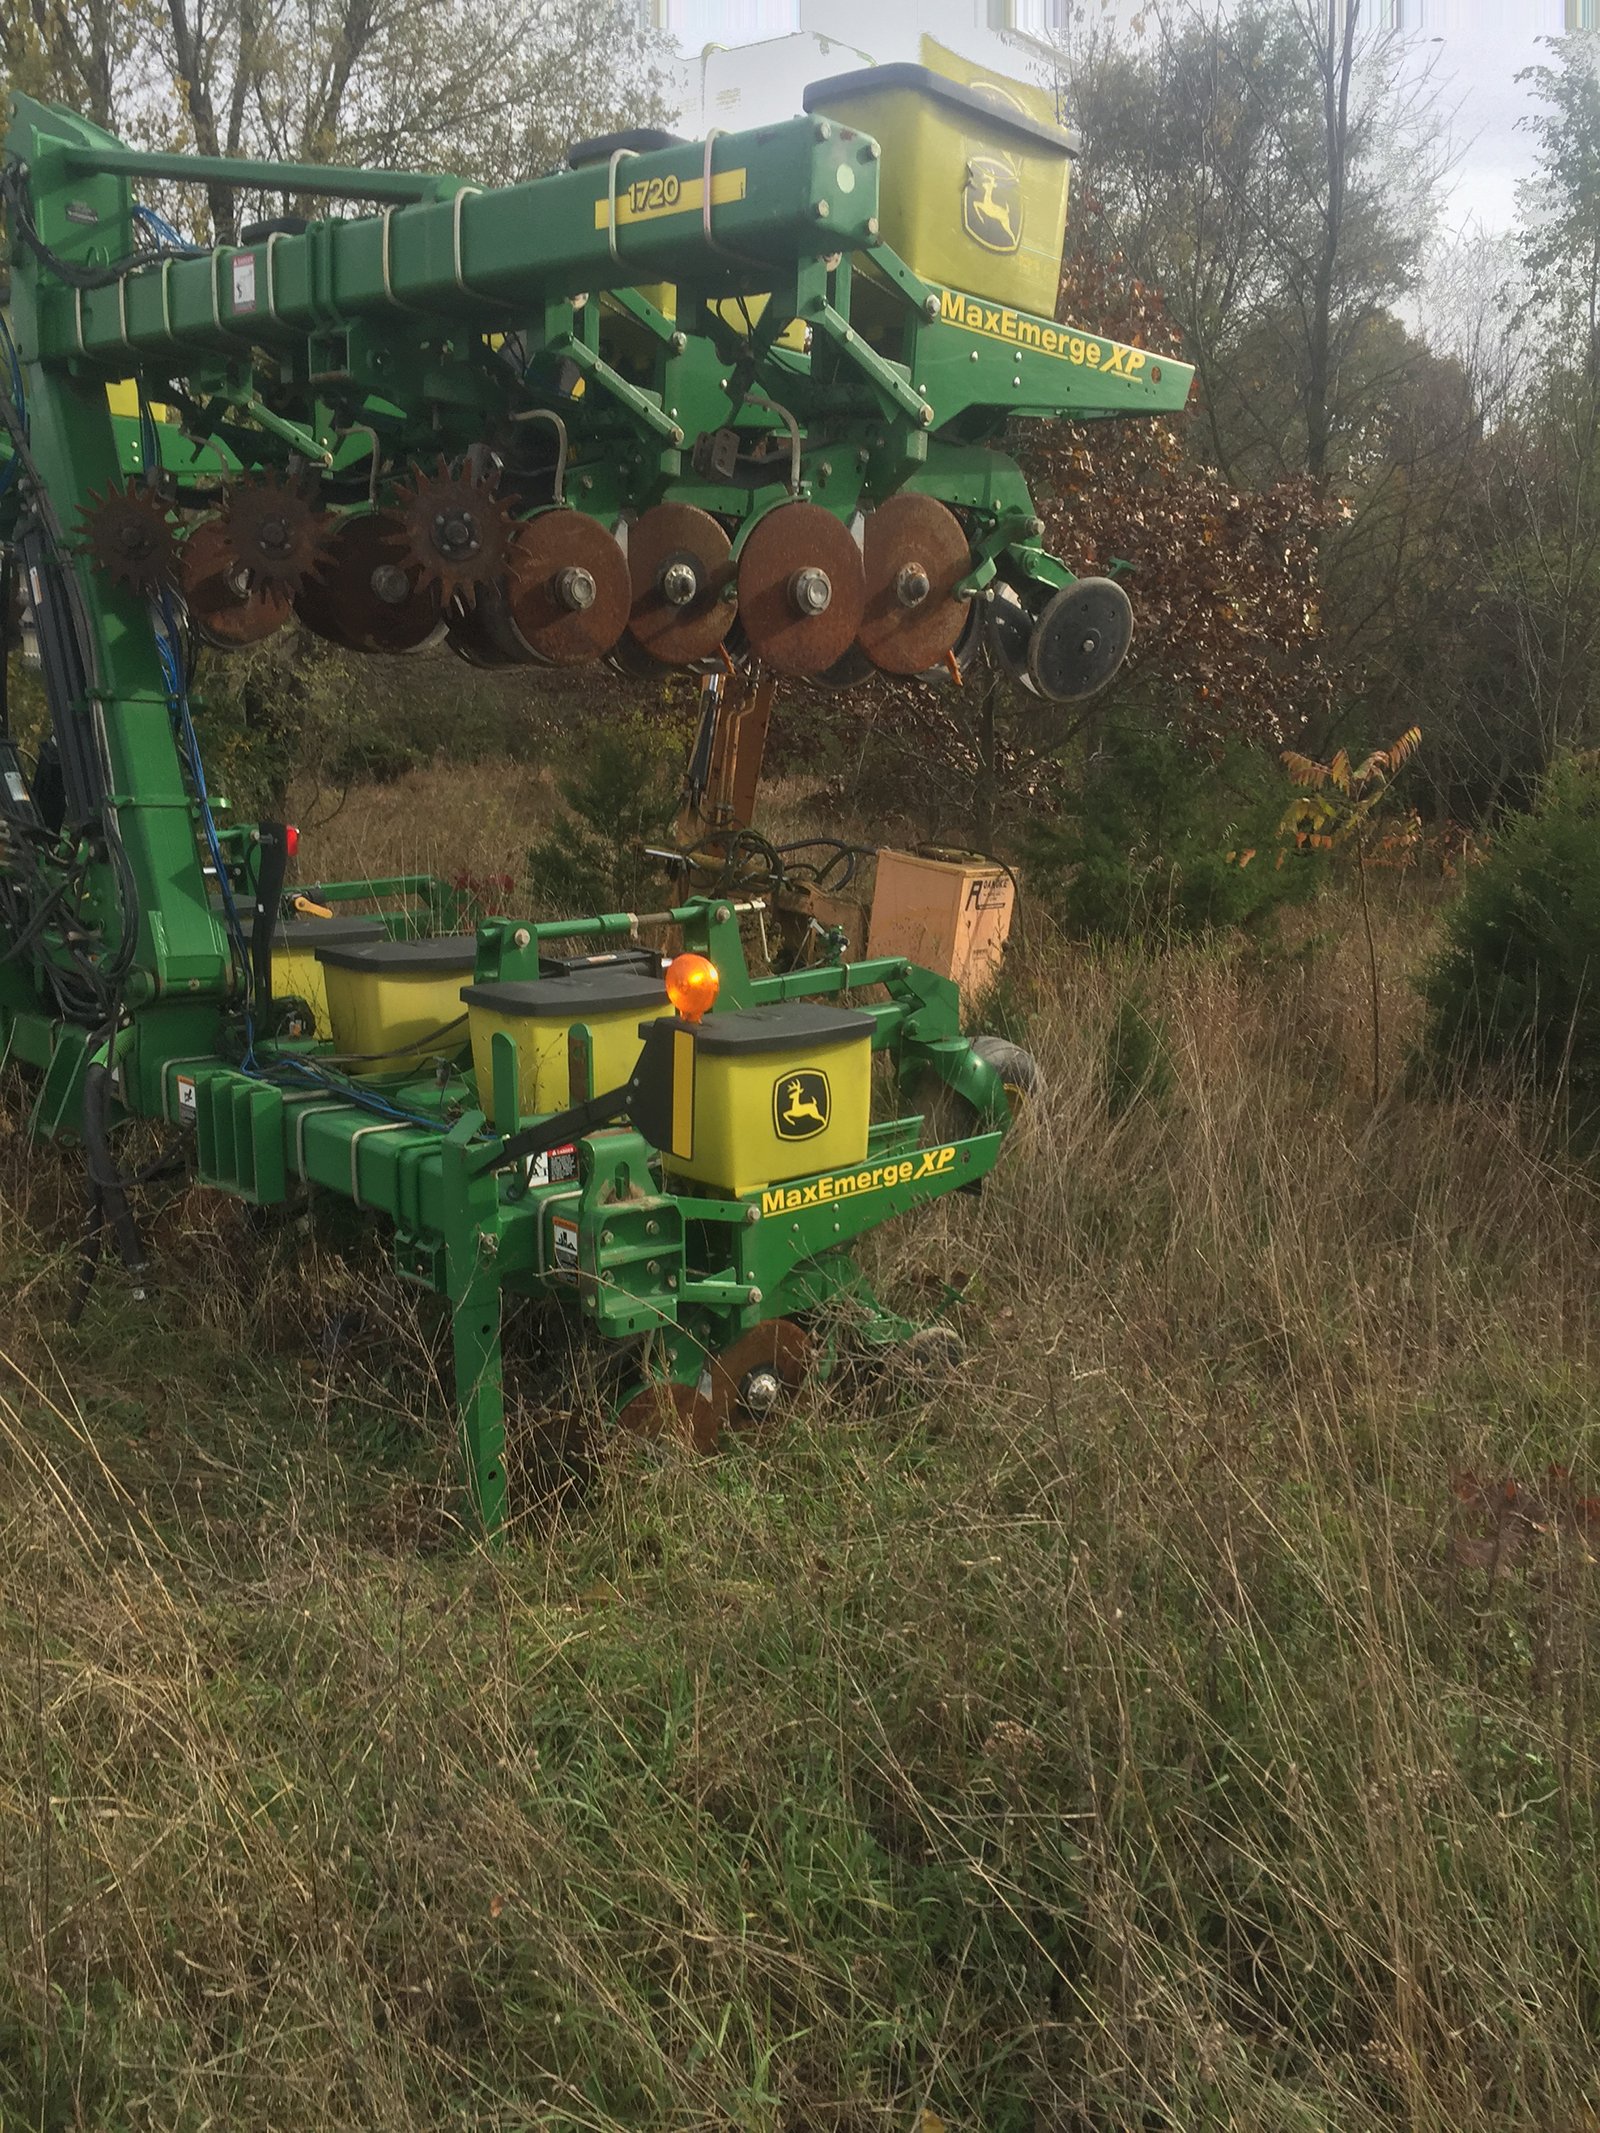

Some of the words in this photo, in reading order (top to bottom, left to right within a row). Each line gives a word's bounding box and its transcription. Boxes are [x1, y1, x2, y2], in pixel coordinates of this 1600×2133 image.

[628, 175, 680, 213] 1720
[941, 290, 1100, 365] MaxEmerge
[1099, 343, 1146, 374] XP
[762, 1161, 913, 1214] MaxEmerge
[912, 1147, 956, 1180] XP
